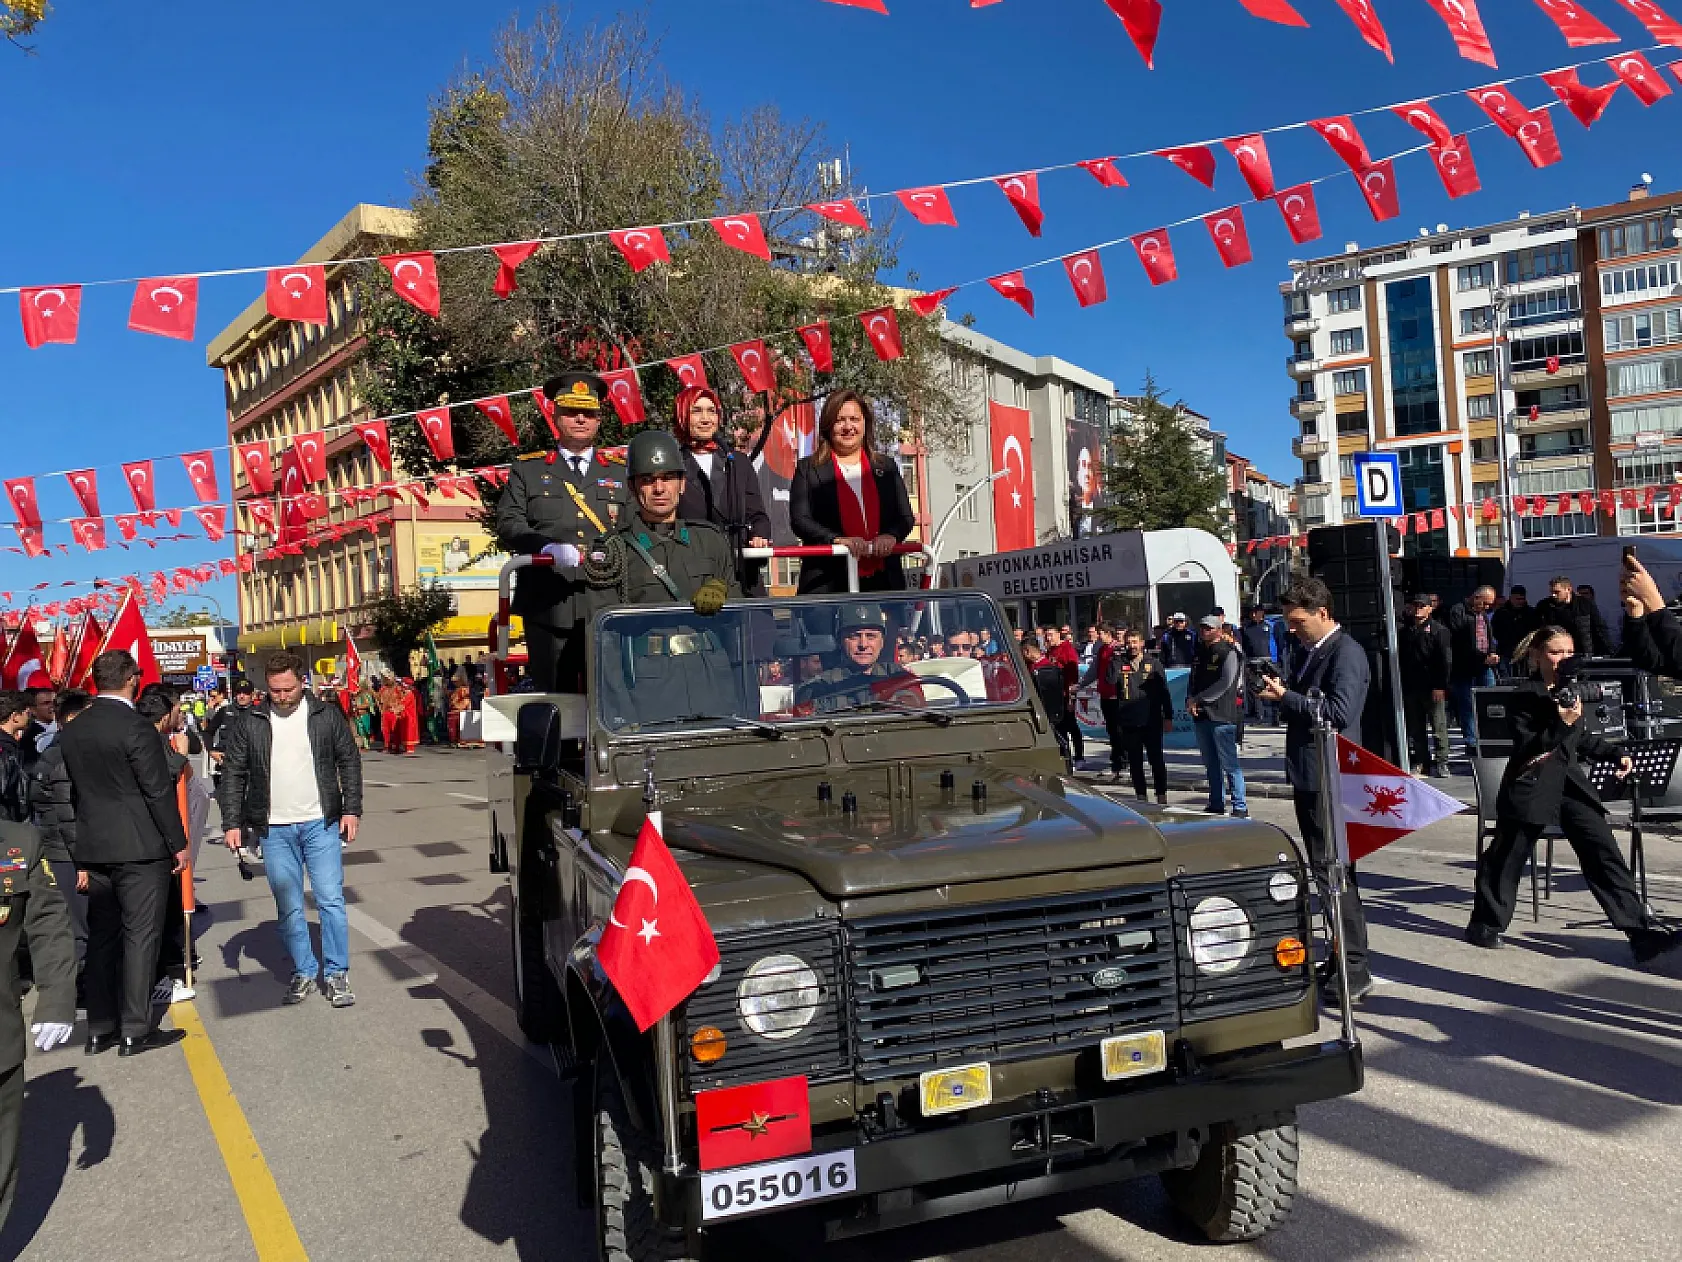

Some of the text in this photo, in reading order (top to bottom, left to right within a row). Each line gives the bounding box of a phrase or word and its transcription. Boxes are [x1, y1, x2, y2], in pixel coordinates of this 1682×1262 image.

[1368, 468, 1388, 502] D
[978, 543, 1113, 577] AFYONKARAHİSAR
[1003, 566, 1091, 595] BELEDİYESİ
[711, 1162, 849, 1211] 055016
